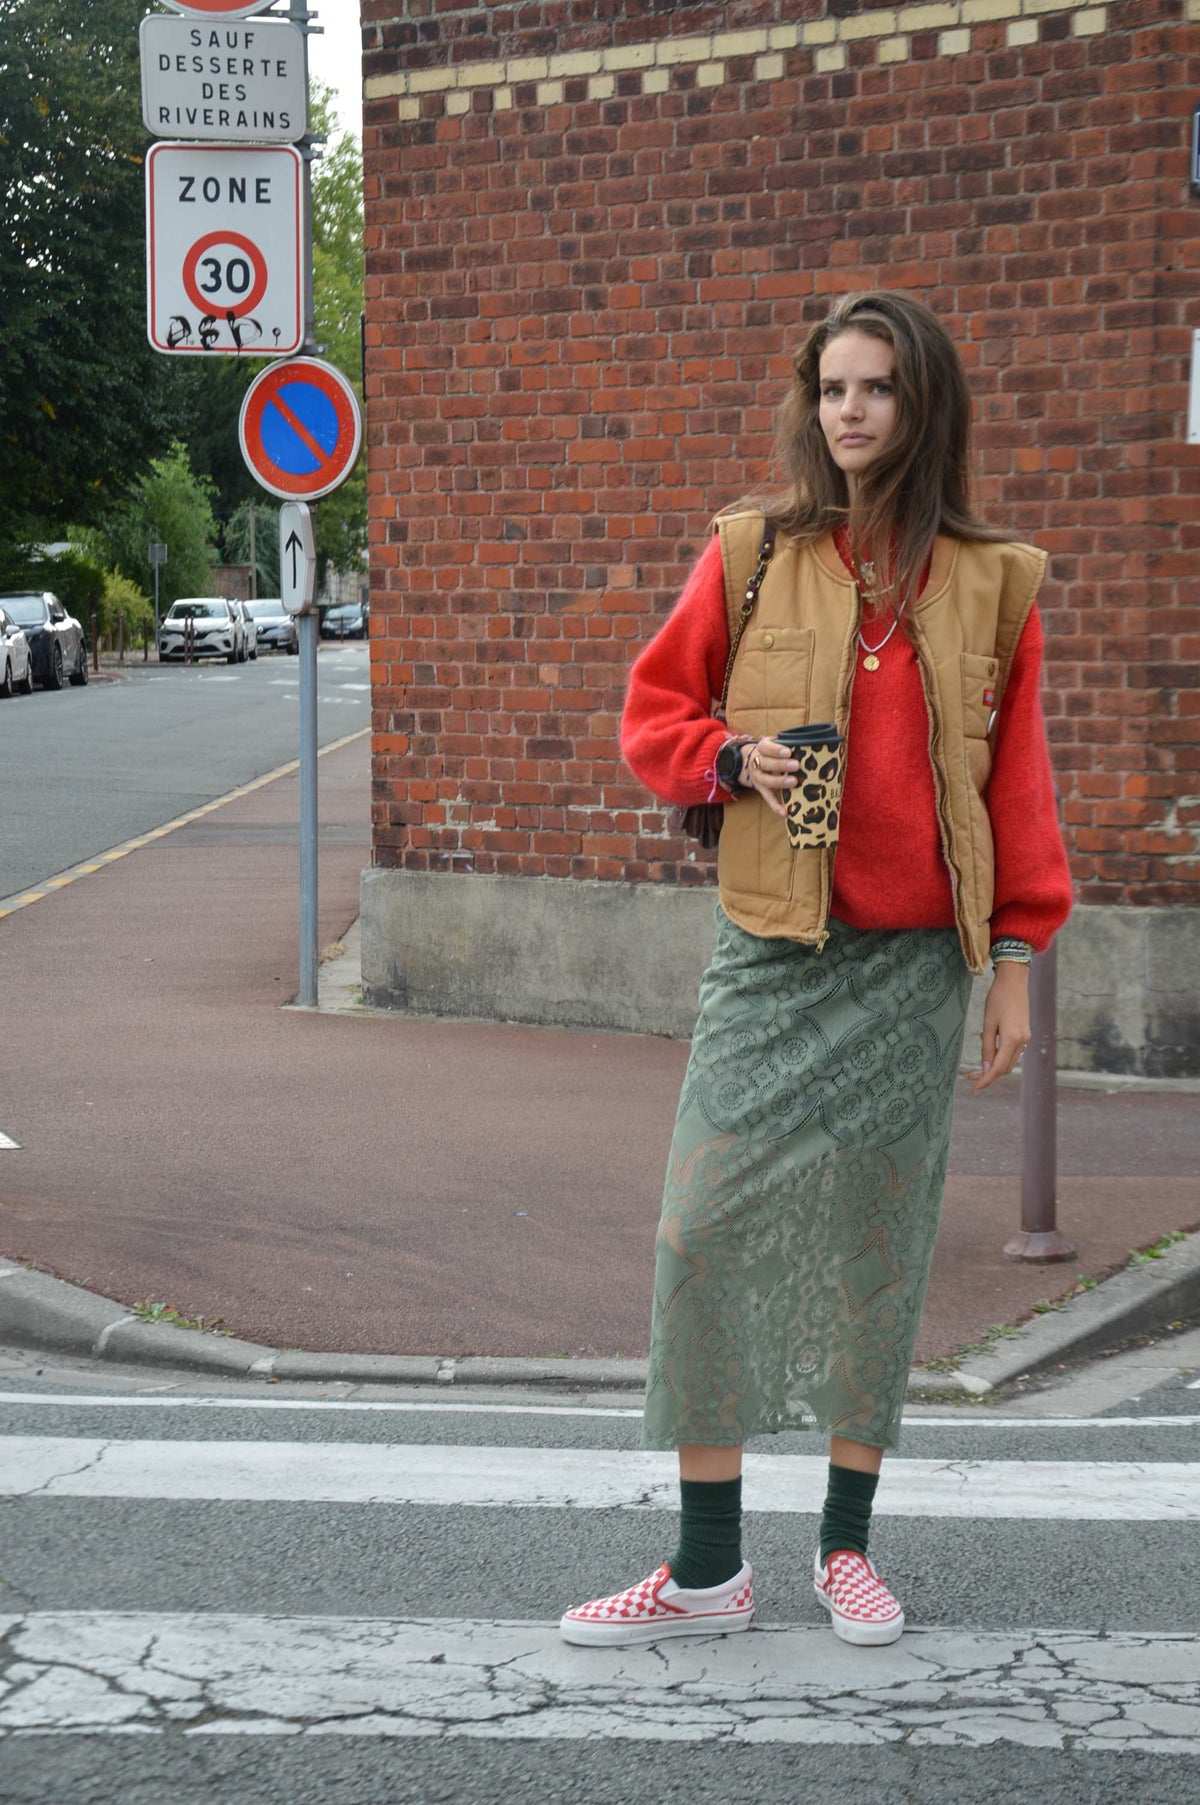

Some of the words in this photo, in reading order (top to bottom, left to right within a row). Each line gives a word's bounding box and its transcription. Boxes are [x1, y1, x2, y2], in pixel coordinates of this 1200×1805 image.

[190, 29, 255, 49] SAUF
[158, 54, 288, 78] DESSERTE
[202, 83, 247, 102] DES
[159, 107, 291, 130] RIVERAINS
[178, 176, 272, 204] ZONE
[200, 257, 251, 294] 30
